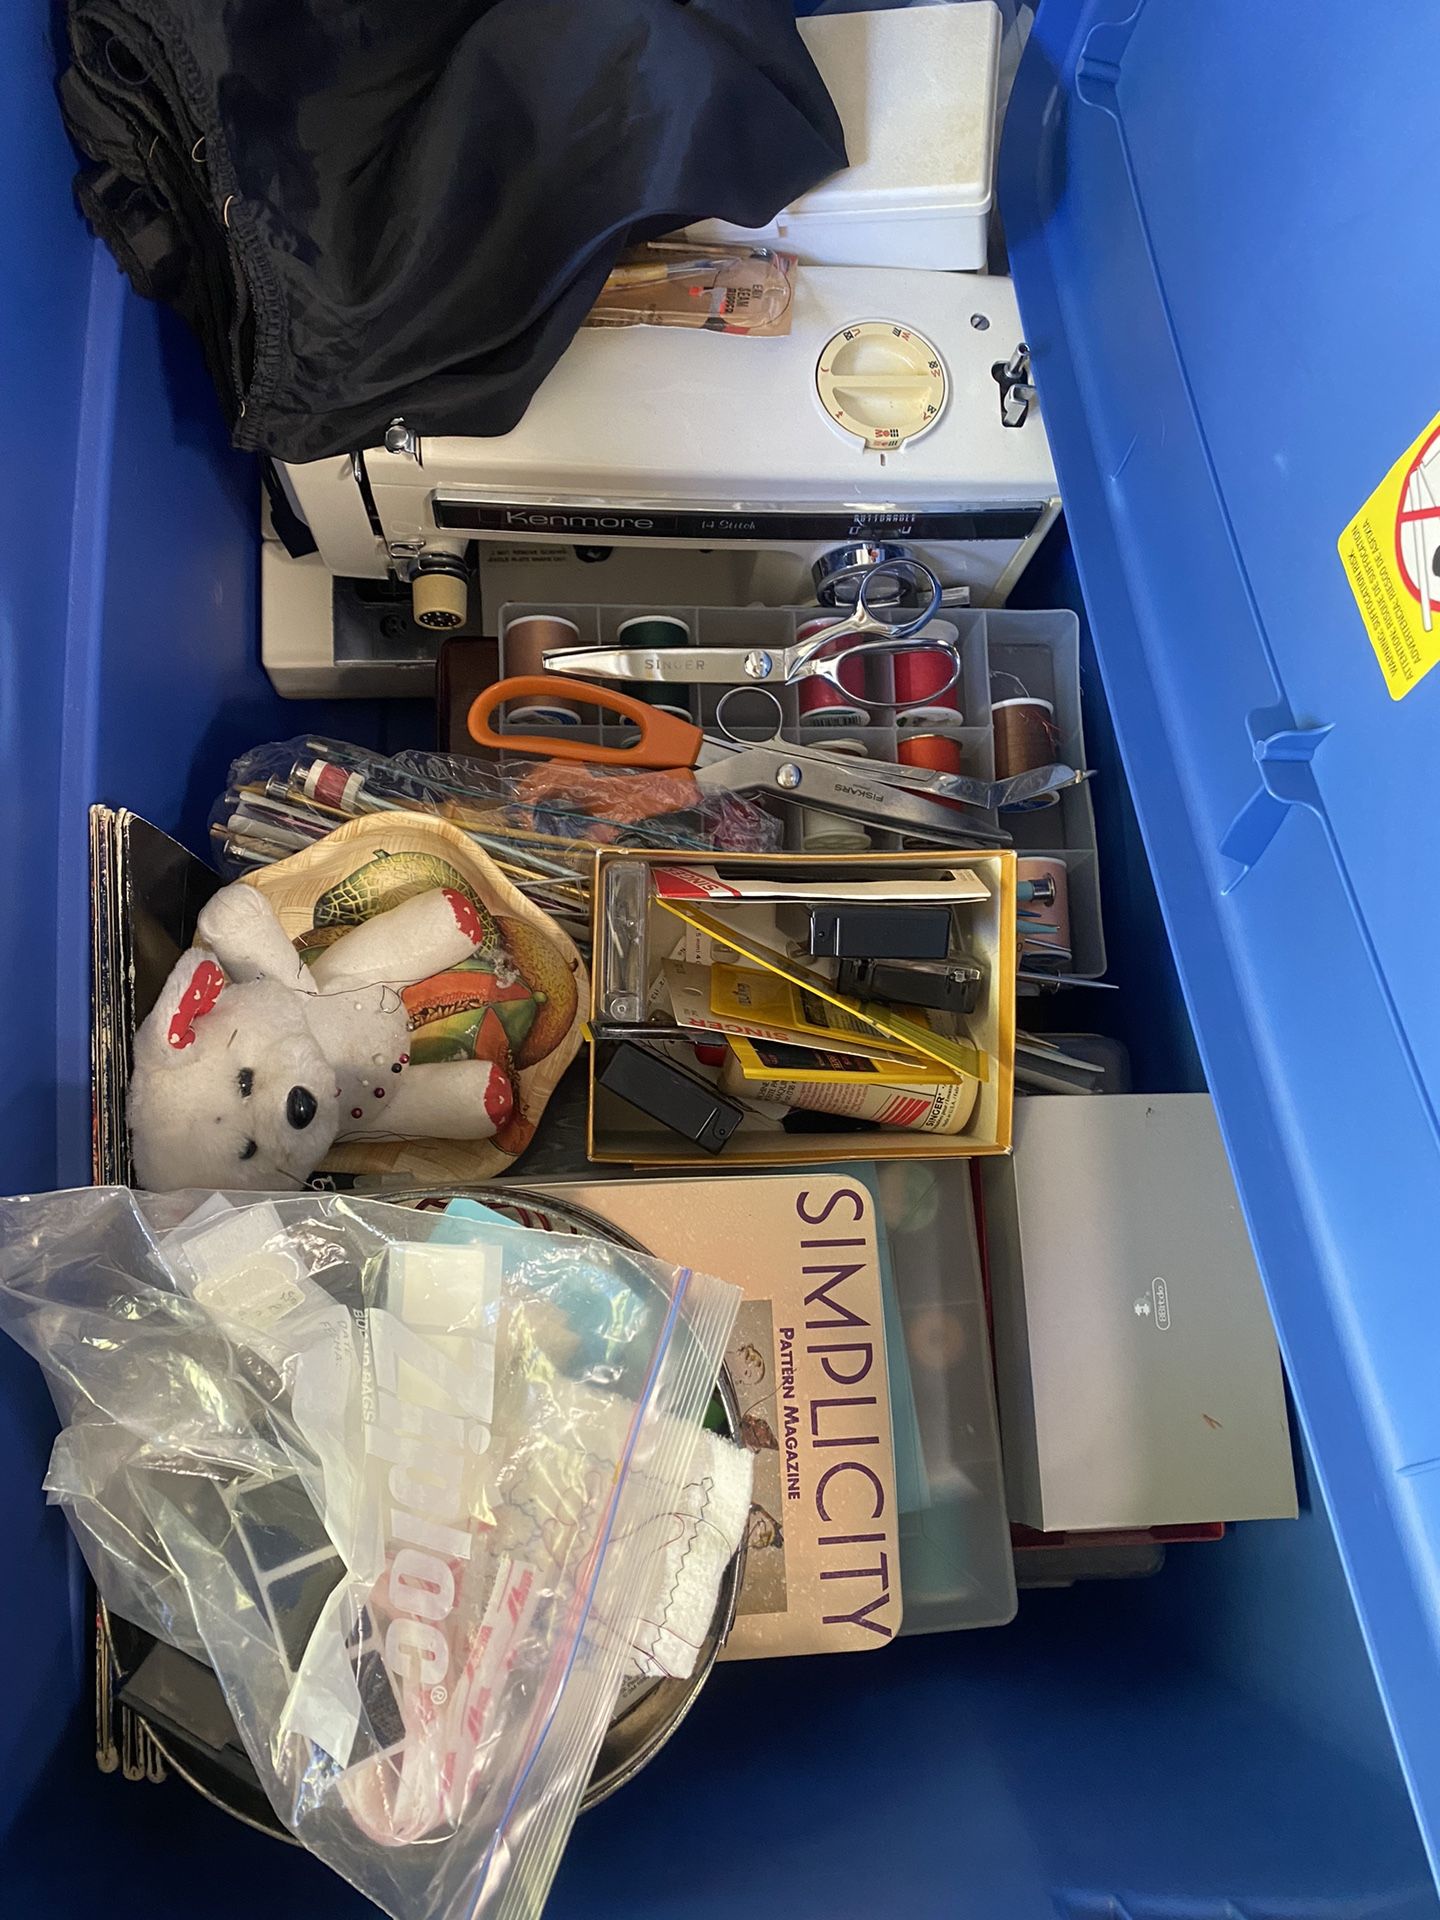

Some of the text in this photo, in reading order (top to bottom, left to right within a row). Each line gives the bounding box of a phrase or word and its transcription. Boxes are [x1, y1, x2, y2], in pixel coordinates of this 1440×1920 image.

[725, 287, 736, 313] RIPPER
[737, 287, 751, 307] SEAM
[506, 511, 654, 529] Kenmore
[702, 519, 756, 530] 14 Stitch
[1352, 525, 1414, 681] ATTENTION: RISQUE DE SUFFOCATION
[1362, 518, 1421, 664] ADVERTENCIA: RIESGO DE ASFIXIA
[1347, 551, 1398, 678] WARNING: SUFFOCATION RISK
[644, 658, 705, 671] SINGER
[834, 782, 885, 803] FISKARS
[687, 1017, 791, 1042] SINGER
[361, 1368, 377, 1423] BAGS
[778, 1326, 801, 1501] PATTERN MAGAZINE
[796, 1188, 893, 1638] SIMPLICITY
